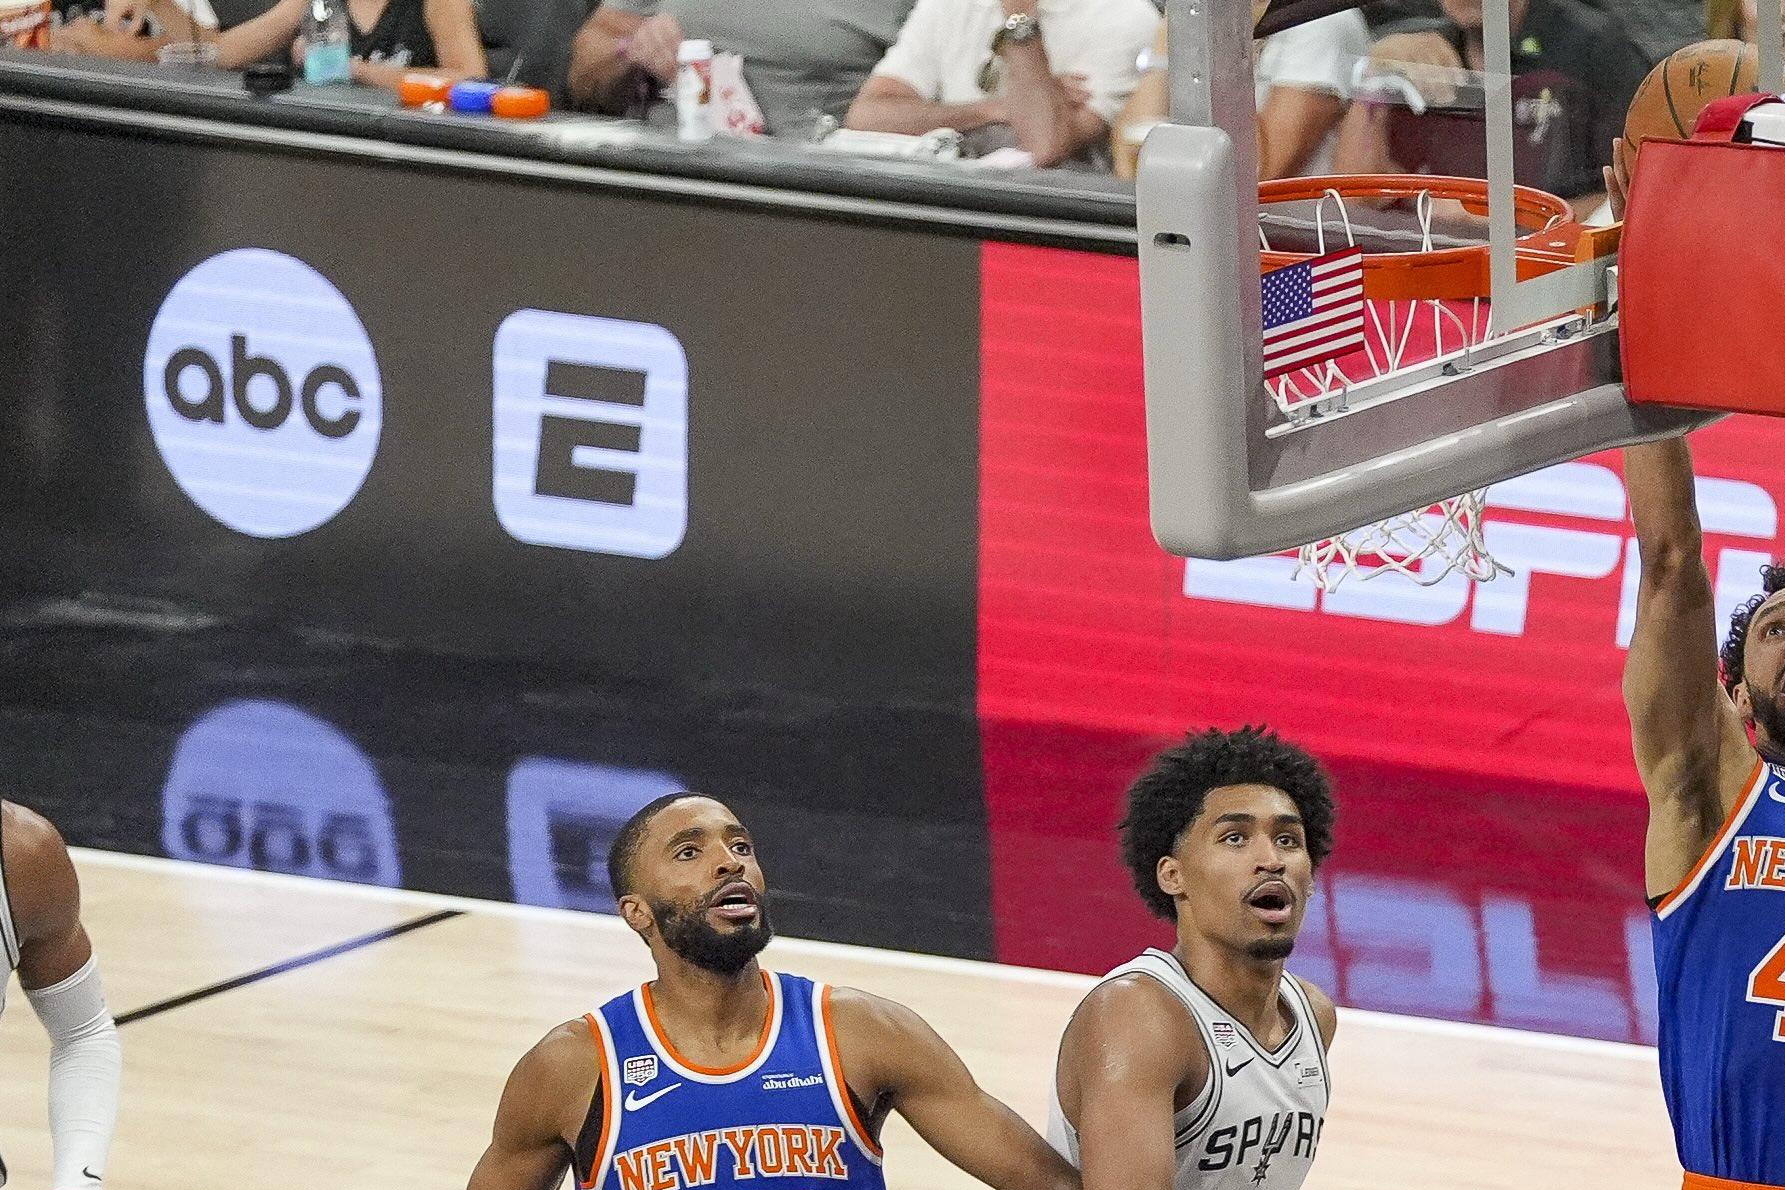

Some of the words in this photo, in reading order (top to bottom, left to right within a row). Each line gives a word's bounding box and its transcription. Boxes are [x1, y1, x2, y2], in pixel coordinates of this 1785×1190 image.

[163, 333, 363, 439] abc
[787, 1072, 824, 1088] dhabi
[723, 1123, 849, 1181] YORK
[1198, 1111, 1325, 1187] SPUR
